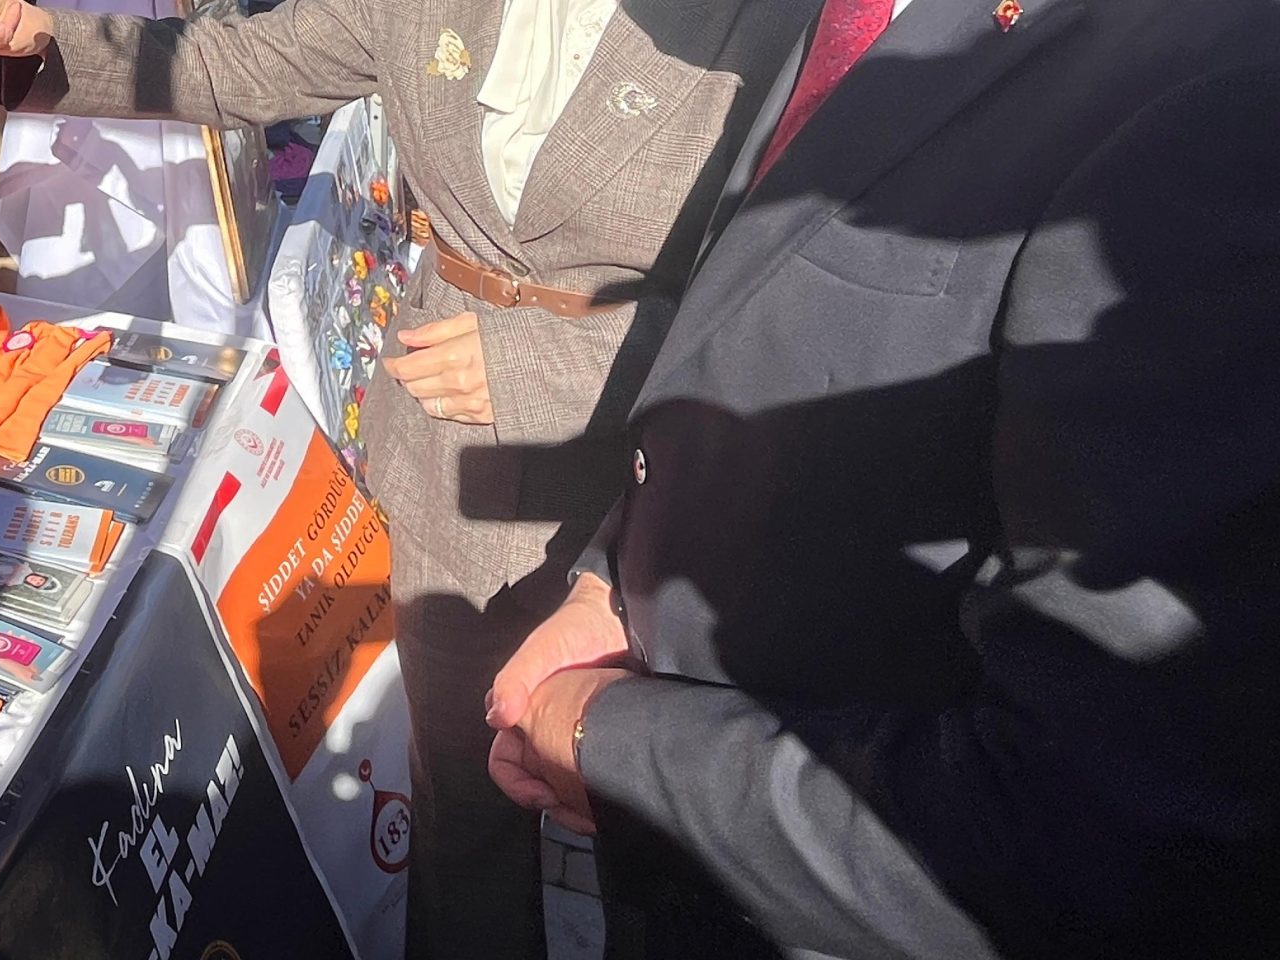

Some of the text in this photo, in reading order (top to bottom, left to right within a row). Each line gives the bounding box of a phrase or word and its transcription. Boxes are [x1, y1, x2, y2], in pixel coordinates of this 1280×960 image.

[257, 537, 308, 614] ŞİDDET
[295, 573, 316, 603] YA
[312, 546, 334, 578] DA
[294, 592, 336, 648] TANIK
[288, 575, 392, 738] SESSİZ KALM
[139, 814, 180, 894] EL
[379, 808, 410, 858] 183
